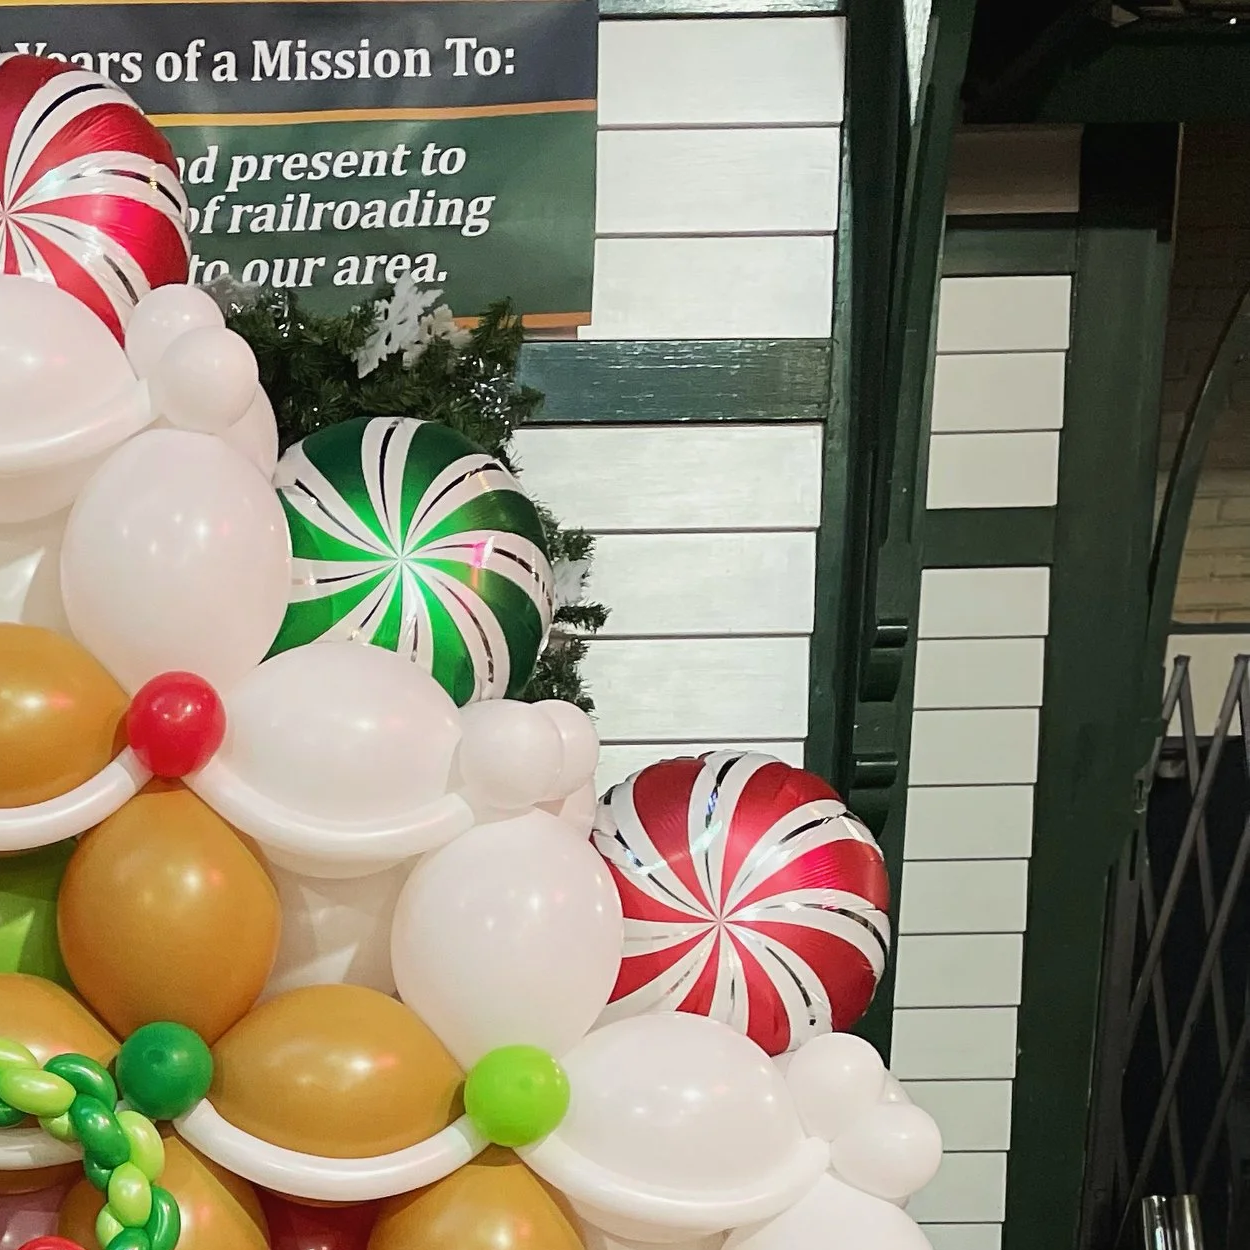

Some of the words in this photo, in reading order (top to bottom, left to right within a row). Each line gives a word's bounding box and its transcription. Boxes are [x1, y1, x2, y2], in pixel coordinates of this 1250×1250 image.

[14, 42, 143, 83] ars
[155, 39, 206, 83] of
[211, 50, 238, 83] a
[251, 39, 432, 82] Mission
[445, 37, 515, 77] To:
[225, 144, 411, 192] present
[421, 145, 467, 175] to
[227, 188, 496, 237] railroading
[241, 253, 327, 288] our
[333, 250, 448, 287] area.
